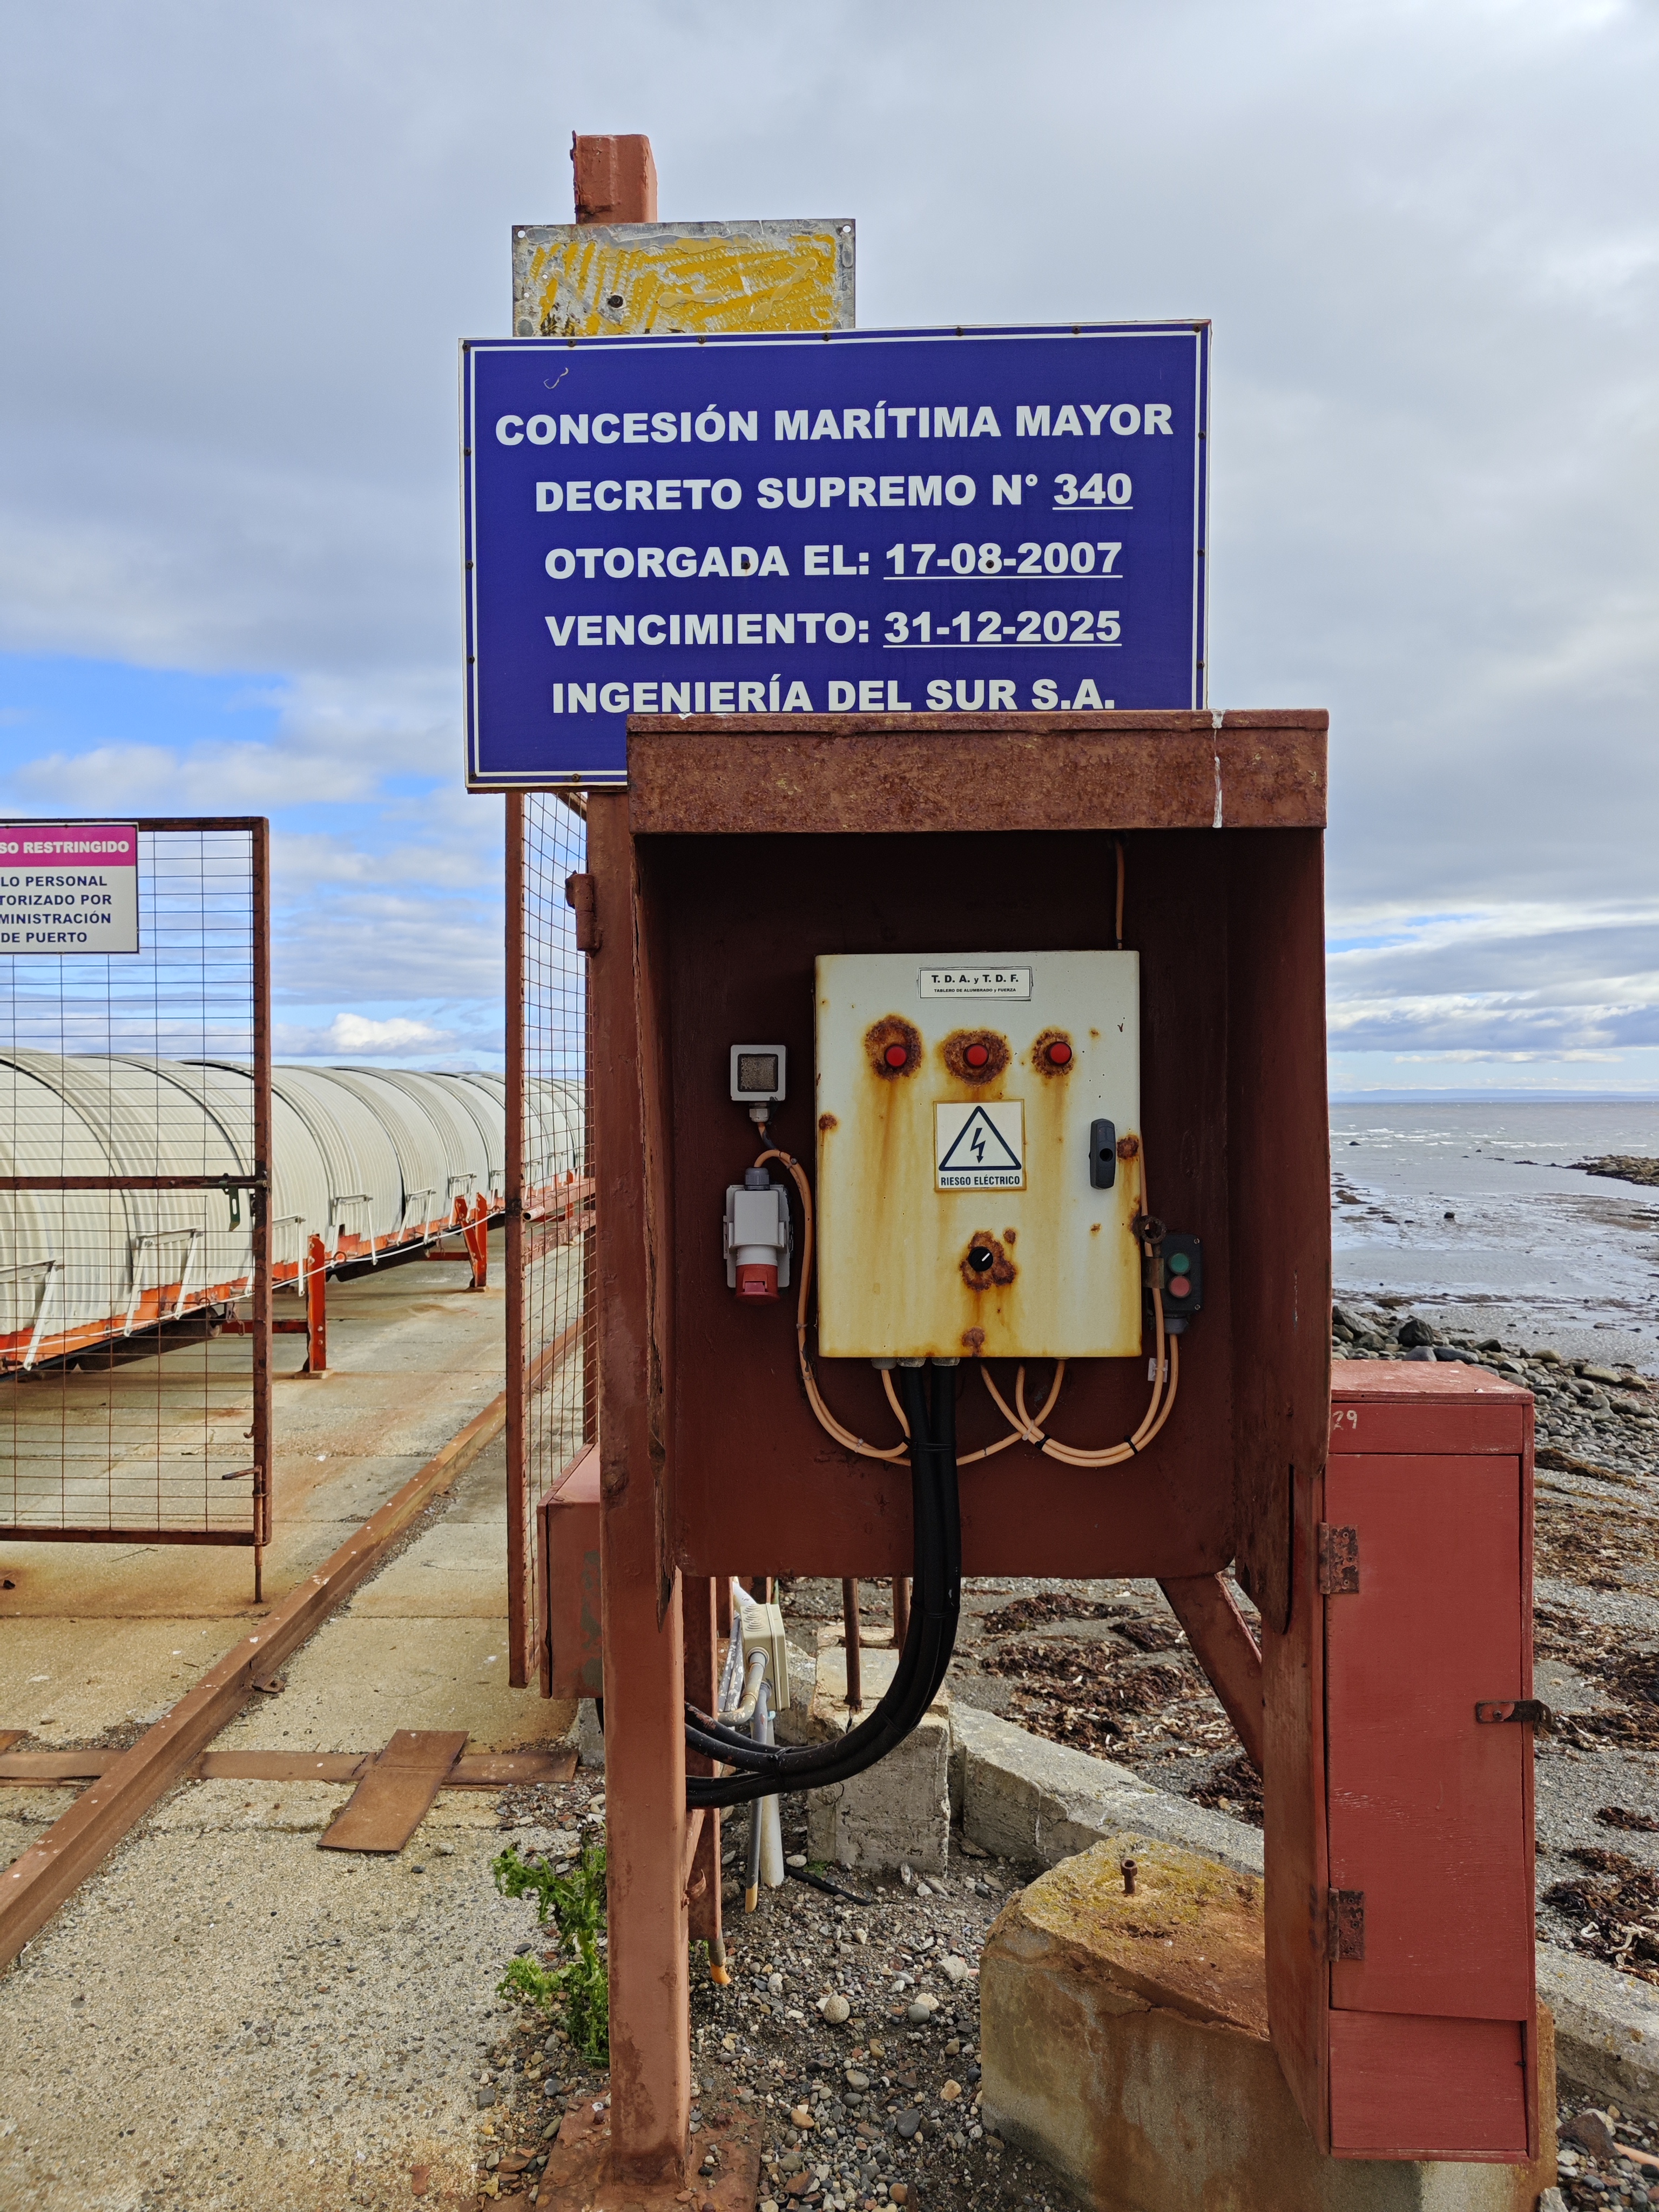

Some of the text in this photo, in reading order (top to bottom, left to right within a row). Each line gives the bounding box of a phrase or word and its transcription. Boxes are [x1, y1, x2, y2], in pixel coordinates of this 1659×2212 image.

[495, 401, 1174, 446] CONCESIÓN MARÍTIMA MAYOR
[536, 478, 742, 512] DECRETO
[757, 475, 976, 509] SUPREMO
[1054, 473, 1131, 504] 340
[545, 542, 1122, 579] OTORGADA EL: 17-08-2007
[545, 610, 1121, 647] VENCIMIENTO: 31-12-2025
[552, 675, 1114, 714] INGENIERÍA DEL SUR S.A.
[0, 841, 129, 854] SO RESTRINGIDO
[1, 876, 107, 887] LO PERSONAL
[0, 895, 112, 905] TORIZADO POR
[0, 911, 111, 923] MINISTRACIÓN
[1, 932, 87, 942] DE PUERTO
[941, 1175, 1020, 1186] RIESGO ELÉCTRICO
